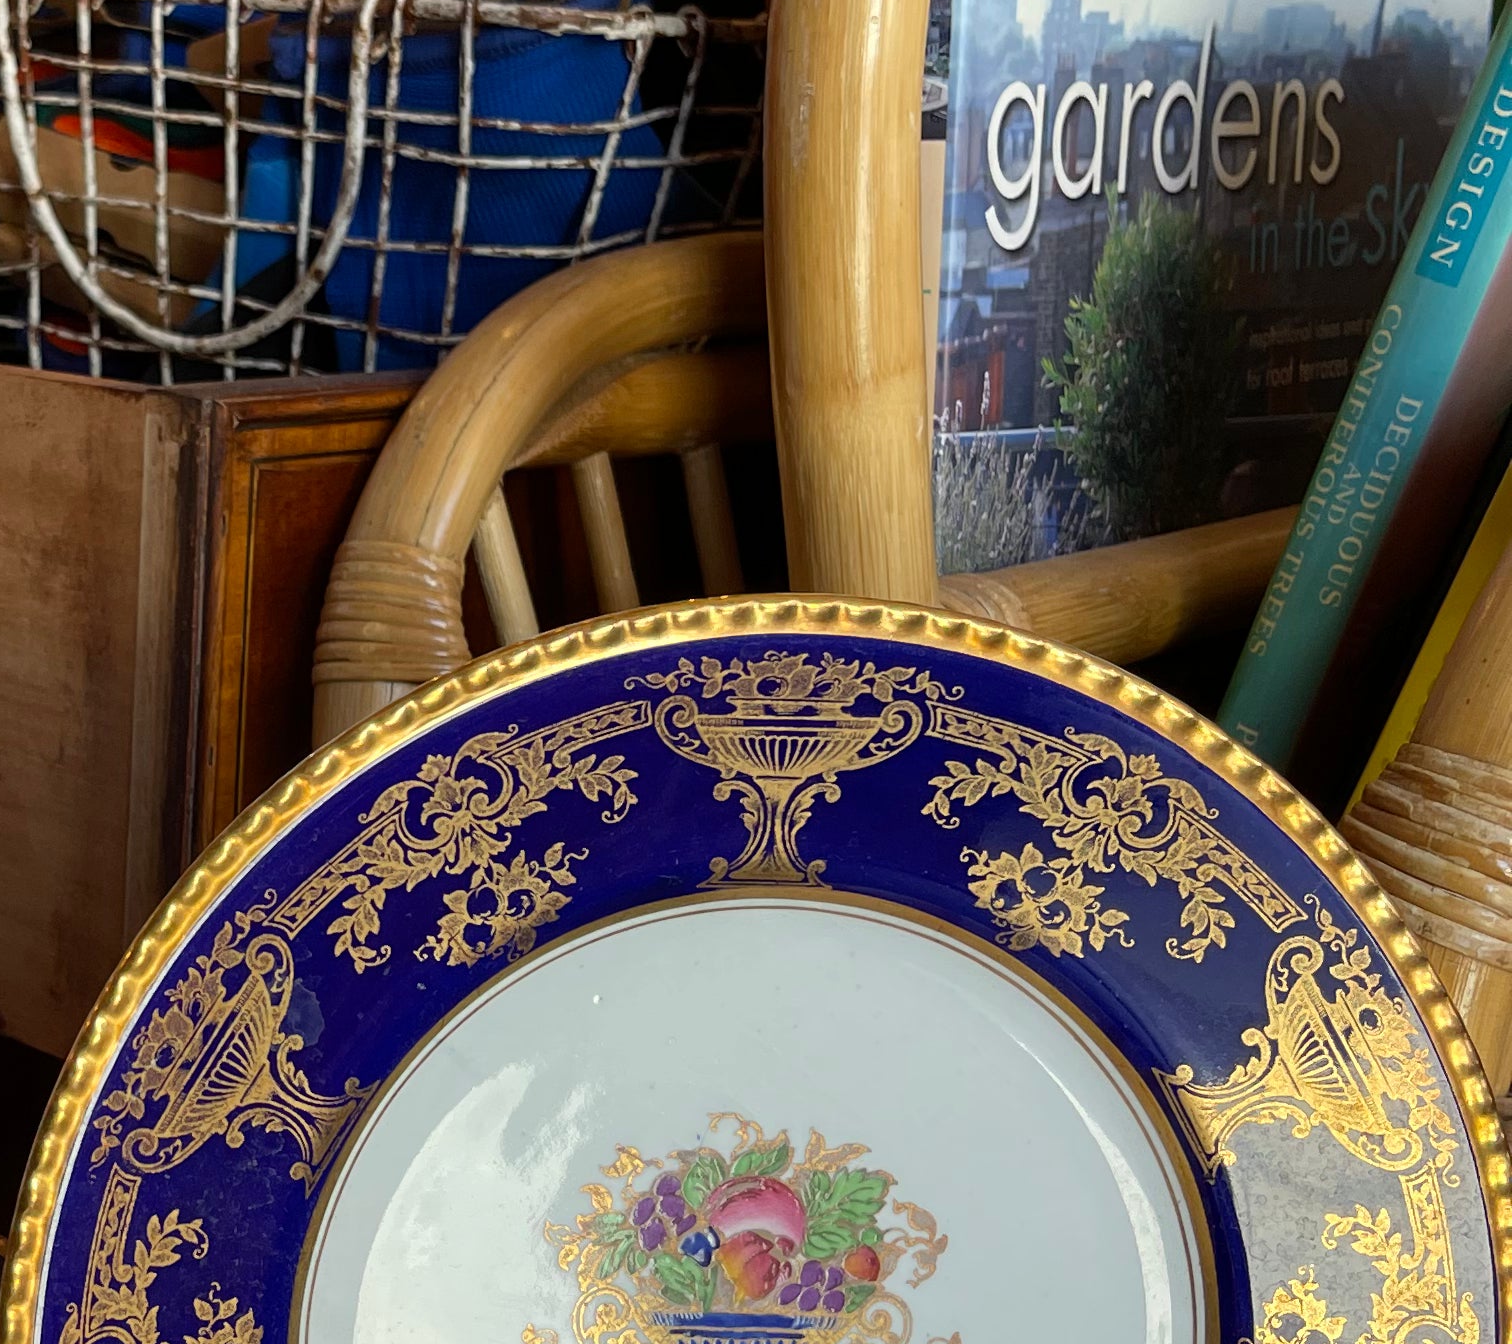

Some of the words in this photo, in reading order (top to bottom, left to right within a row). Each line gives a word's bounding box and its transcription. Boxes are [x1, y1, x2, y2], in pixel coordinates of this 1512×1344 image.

[985, 21, 1345, 251] gardens
[1249, 202, 1278, 274] in
[1294, 191, 1350, 270] the
[1362, 137, 1428, 268] sk
[1429, 84, 1512, 269] DESIGN
[1296, 304, 1402, 542] CONIFEROUS
[1319, 393, 1424, 609] DECIDUOUS
[1327, 460, 1361, 526] AND
[1249, 550, 1305, 657] TREES
